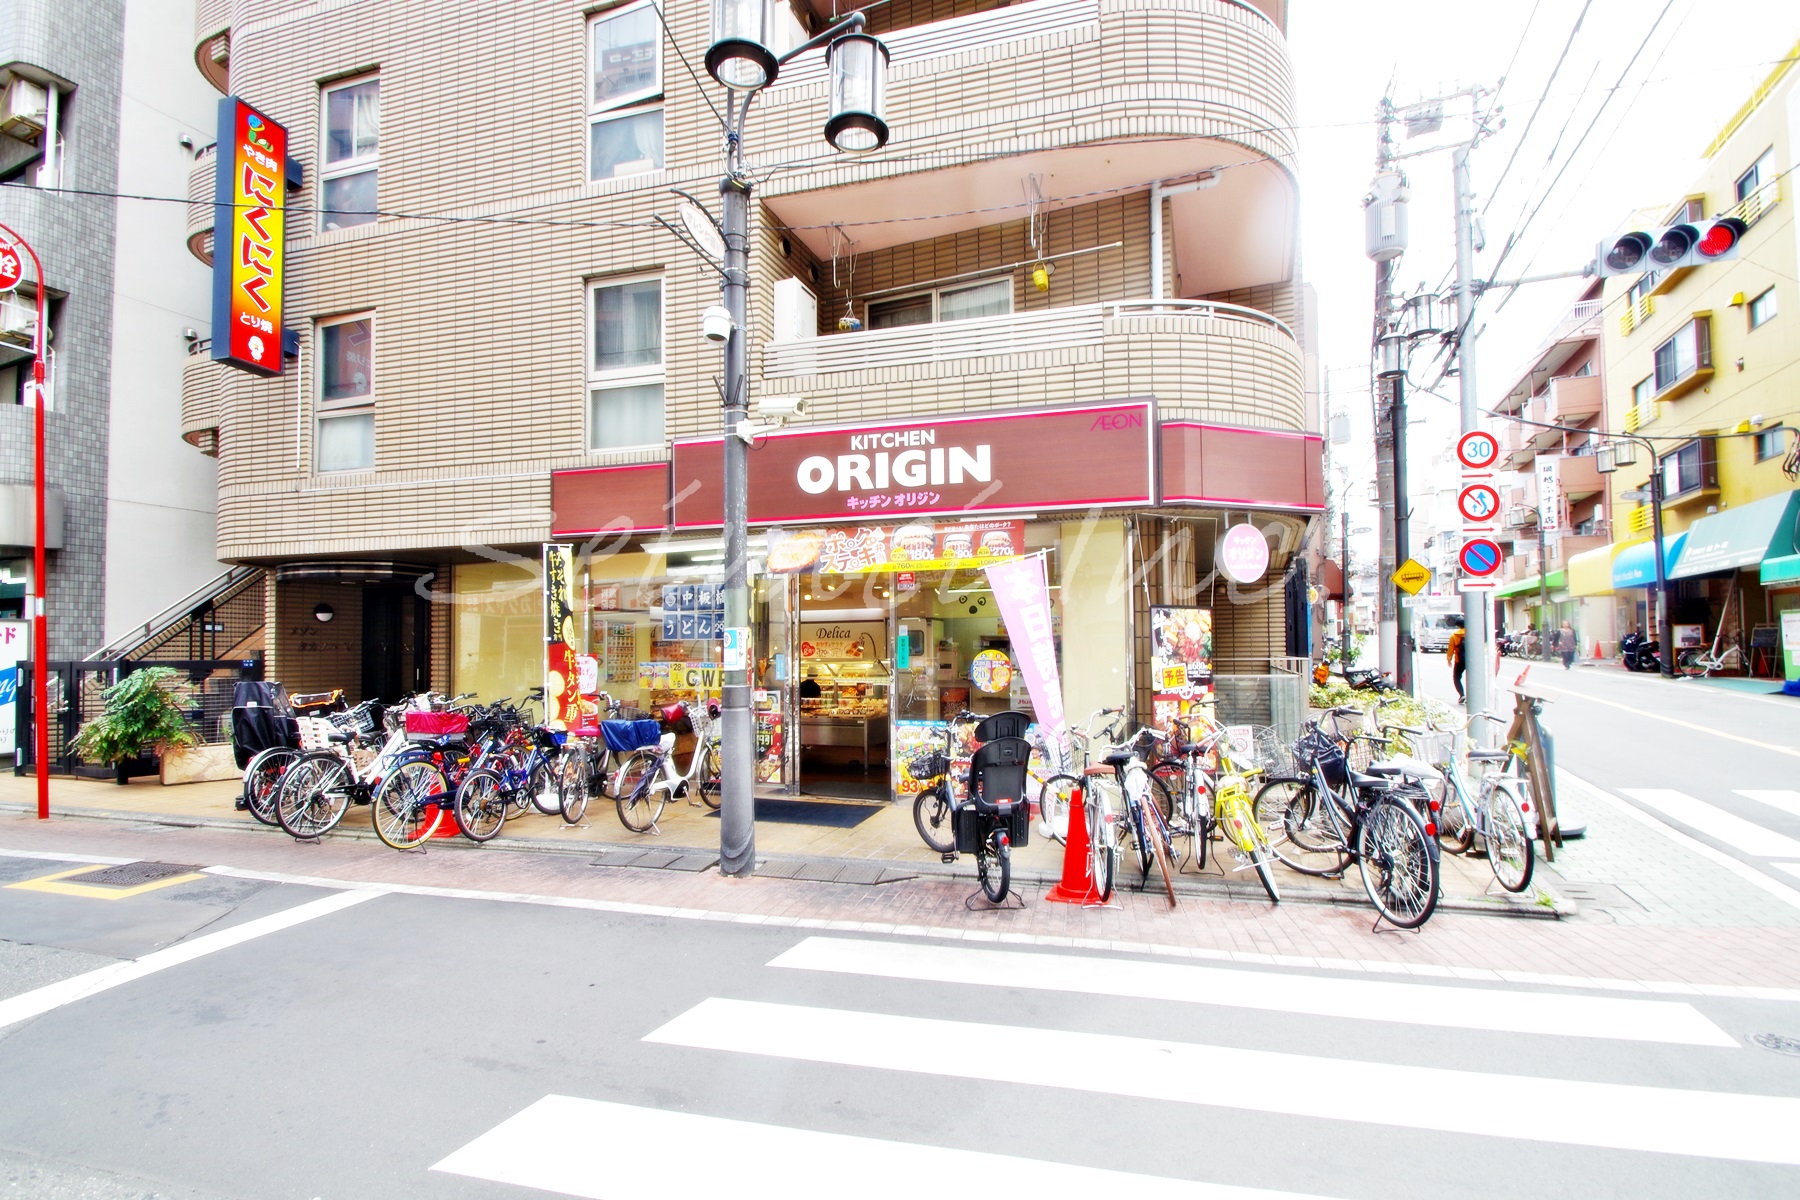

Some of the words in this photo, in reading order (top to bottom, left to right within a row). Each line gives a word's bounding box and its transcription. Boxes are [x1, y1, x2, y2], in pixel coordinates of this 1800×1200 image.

[242, 143, 278, 174] やき肉
[240, 161, 277, 314] にくにく
[240, 311, 273, 335] とり焼
[851, 429, 936, 450] KITCHEN
[1467, 441, 1491, 458] 30
[796, 444, 992, 495] ORIGIN
[847, 494, 892, 510] キッチン
[893, 491, 941, 508] オリジン
[1227, 546, 1264, 561] オリジン
[667, 619, 711, 636] うどん
[816, 625, 851, 639] Delica
[564, 650, 580, 723] 牛タン重
[1164, 668, 1185, 686] 予告
